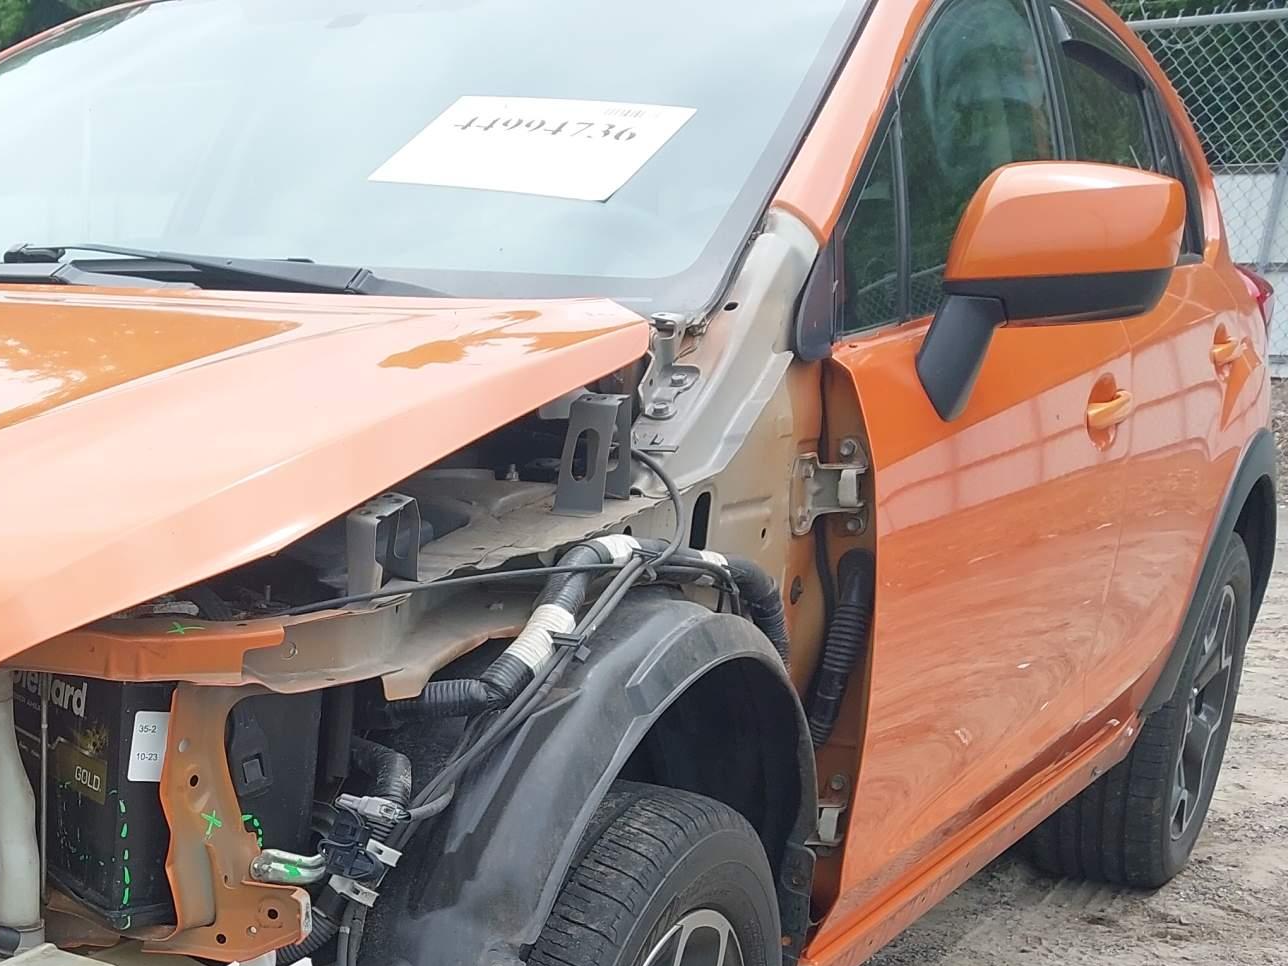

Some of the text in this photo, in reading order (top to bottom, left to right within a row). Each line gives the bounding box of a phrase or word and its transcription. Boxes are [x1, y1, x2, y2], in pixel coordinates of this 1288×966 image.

[454, 116, 638, 142] 44994736
[138, 724, 158, 734] 35-2
[136, 752, 159, 762] 10-23
[74, 765, 101, 792] GOLD
